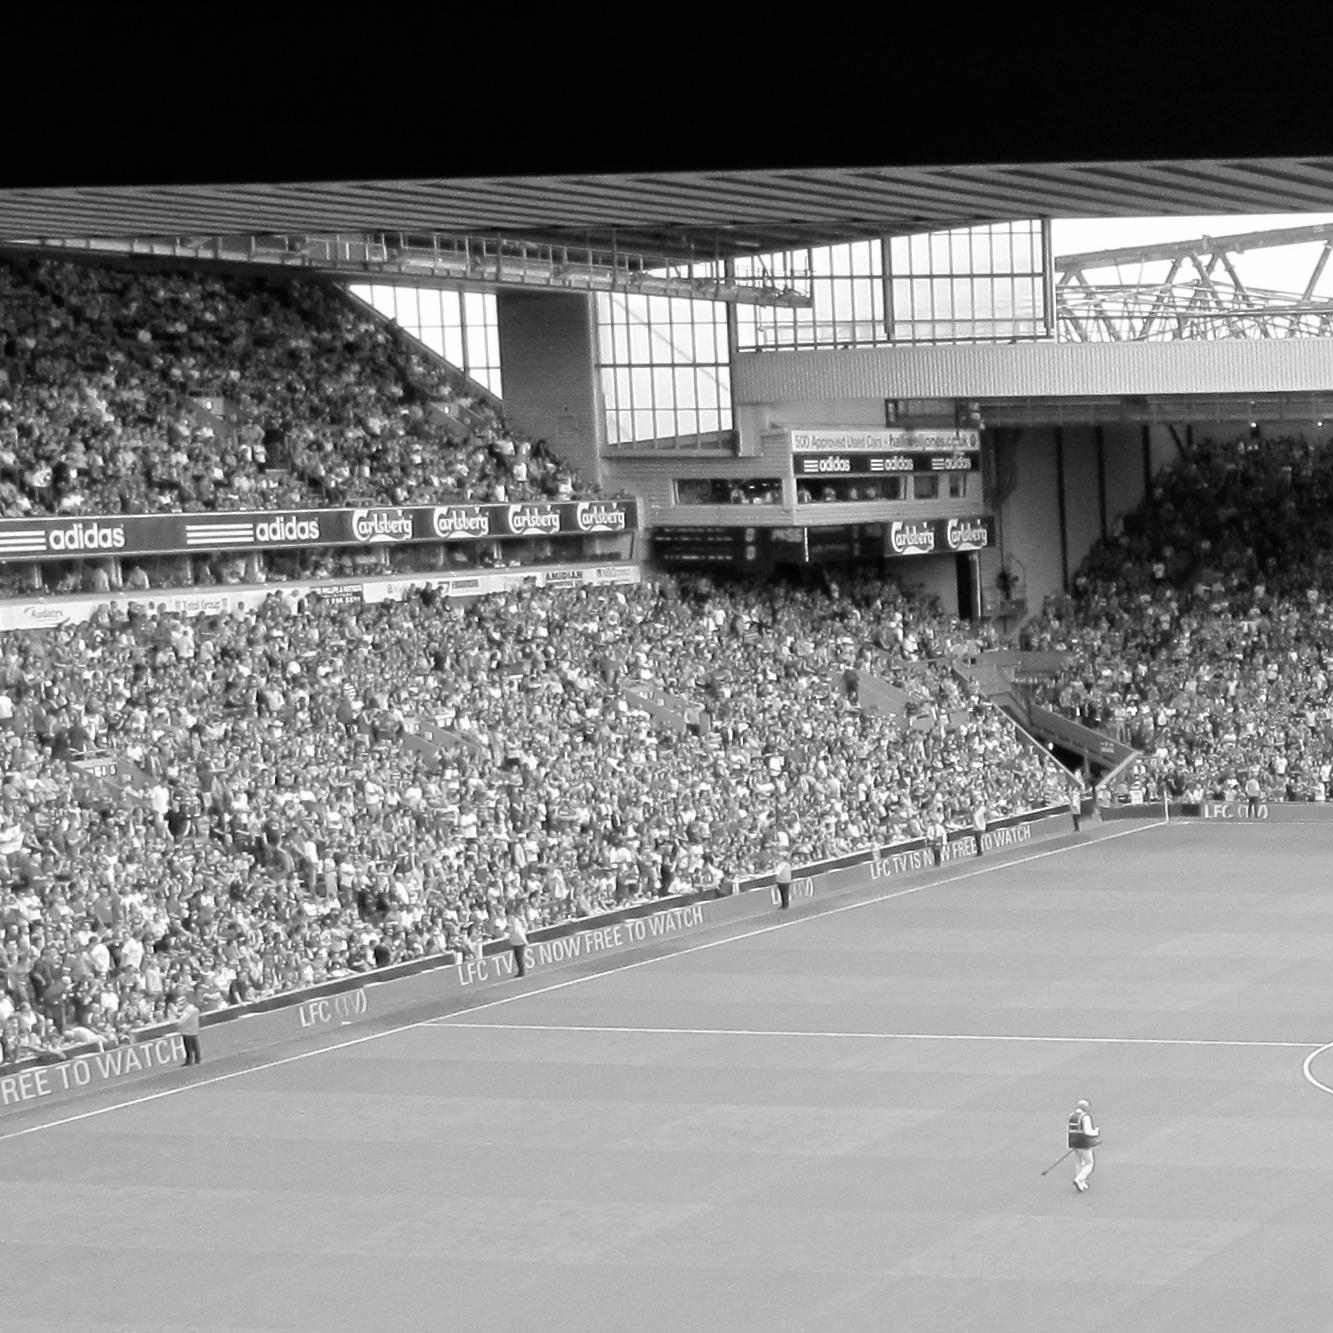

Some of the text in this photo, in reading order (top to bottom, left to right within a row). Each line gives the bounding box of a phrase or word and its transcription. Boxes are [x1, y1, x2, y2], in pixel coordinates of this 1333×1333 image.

[819, 456, 850, 472] adidas
[885, 456, 914, 471] adidas
[256, 516, 320, 542] adidas
[352, 509, 413, 542] Carlsberg
[433, 506, 489, 538] Carlsberg
[508, 504, 560, 535] Carlsberg
[577, 502, 625, 532] Carlsberg
[50, 522, 125, 550] adidas
[891, 521, 934, 555] Carlsberg
[947, 518, 987, 551] Carlsberg
[1204, 804, 1233, 819] LFC
[870, 861, 891, 880] LFC
[892, 855, 907, 873] TV
[910, 852, 921, 869] IS
[923, 845, 950, 867] NW
[952, 837, 977, 859] FREE
[994, 825, 1031, 848] WATCH
[457, 960, 488, 986] LFC
[492, 953, 513, 977] TV
[539, 937, 583, 964] NOW
[584, 926, 623, 954] FREE
[625, 920, 646, 942] TO
[649, 907, 704, 938] WATCH
[299, 1000, 332, 1028] LFC
[55, 1060, 91, 1089] TO
[96, 1034, 187, 1079] WATCH
